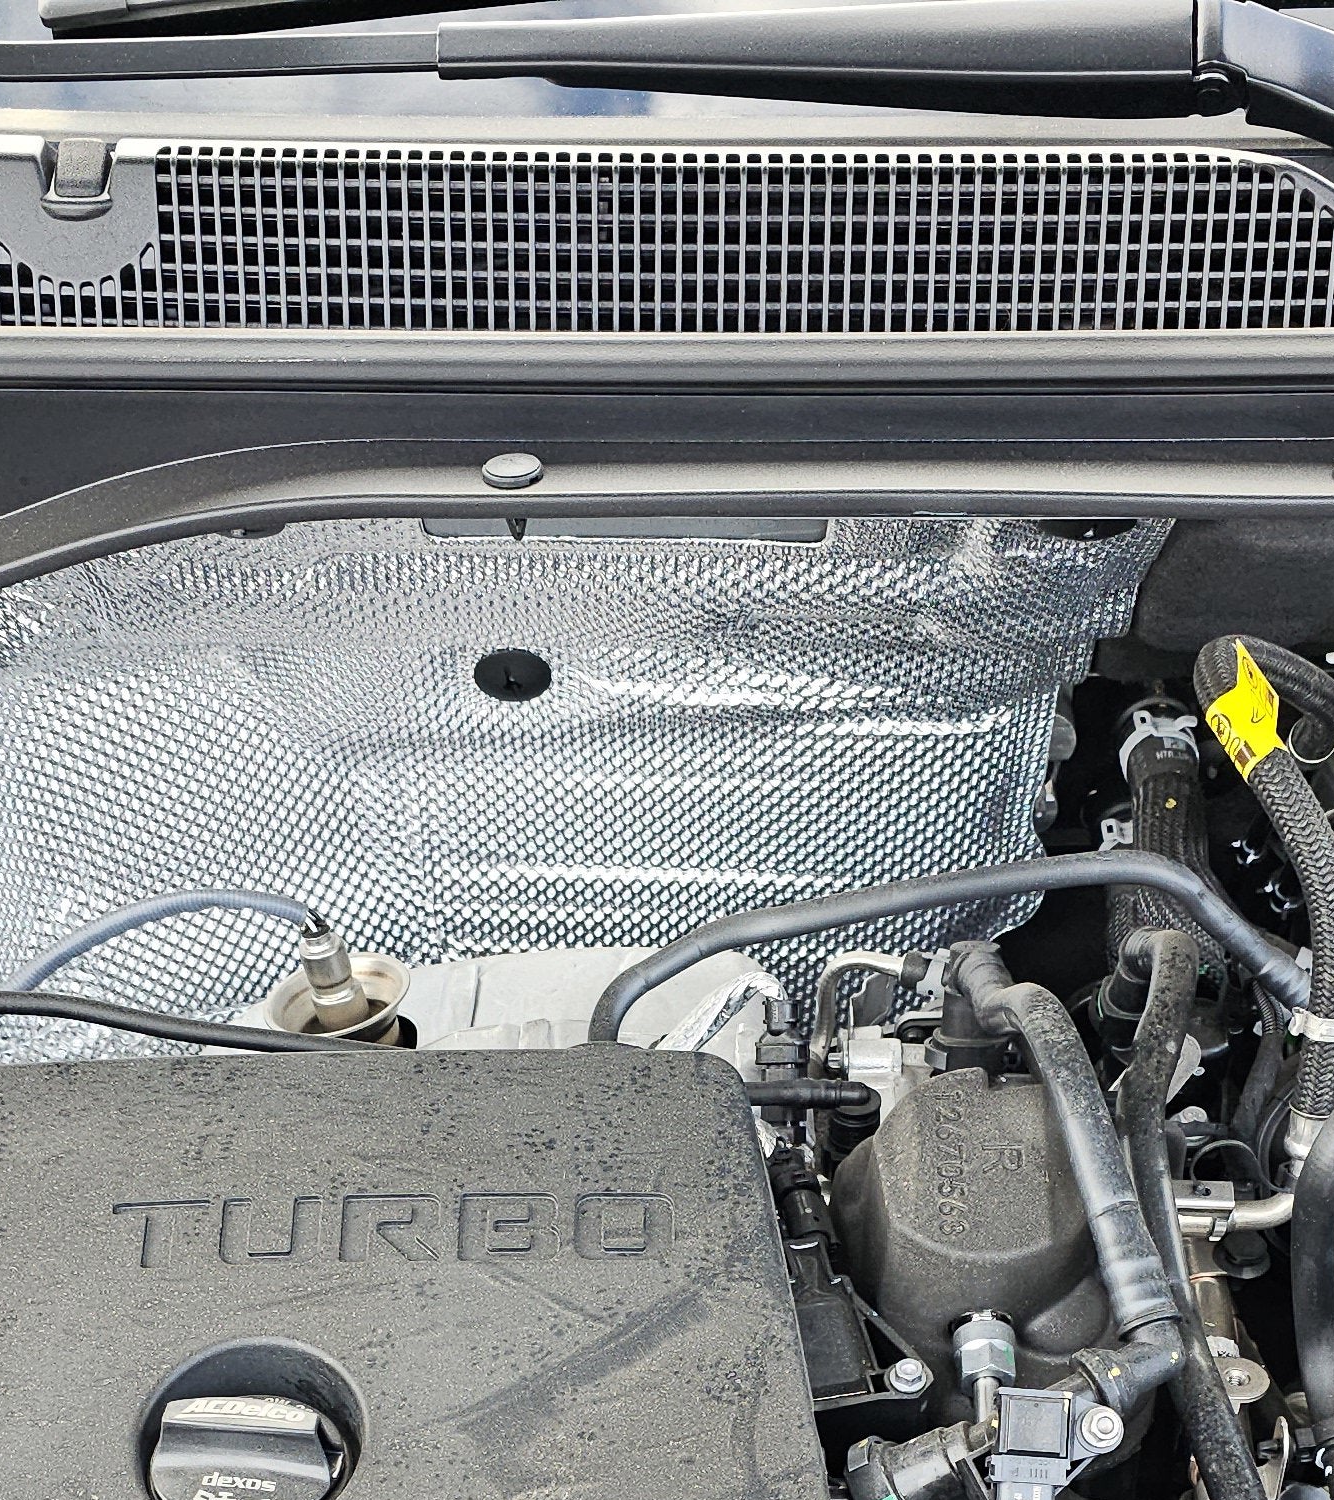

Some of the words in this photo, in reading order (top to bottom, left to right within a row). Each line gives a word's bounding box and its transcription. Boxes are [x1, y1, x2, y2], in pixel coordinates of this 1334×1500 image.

[112, 1191, 676, 1268] TURBO
[182, 1400, 306, 1422] ACDelco
[201, 1472, 277, 1492] dexos
